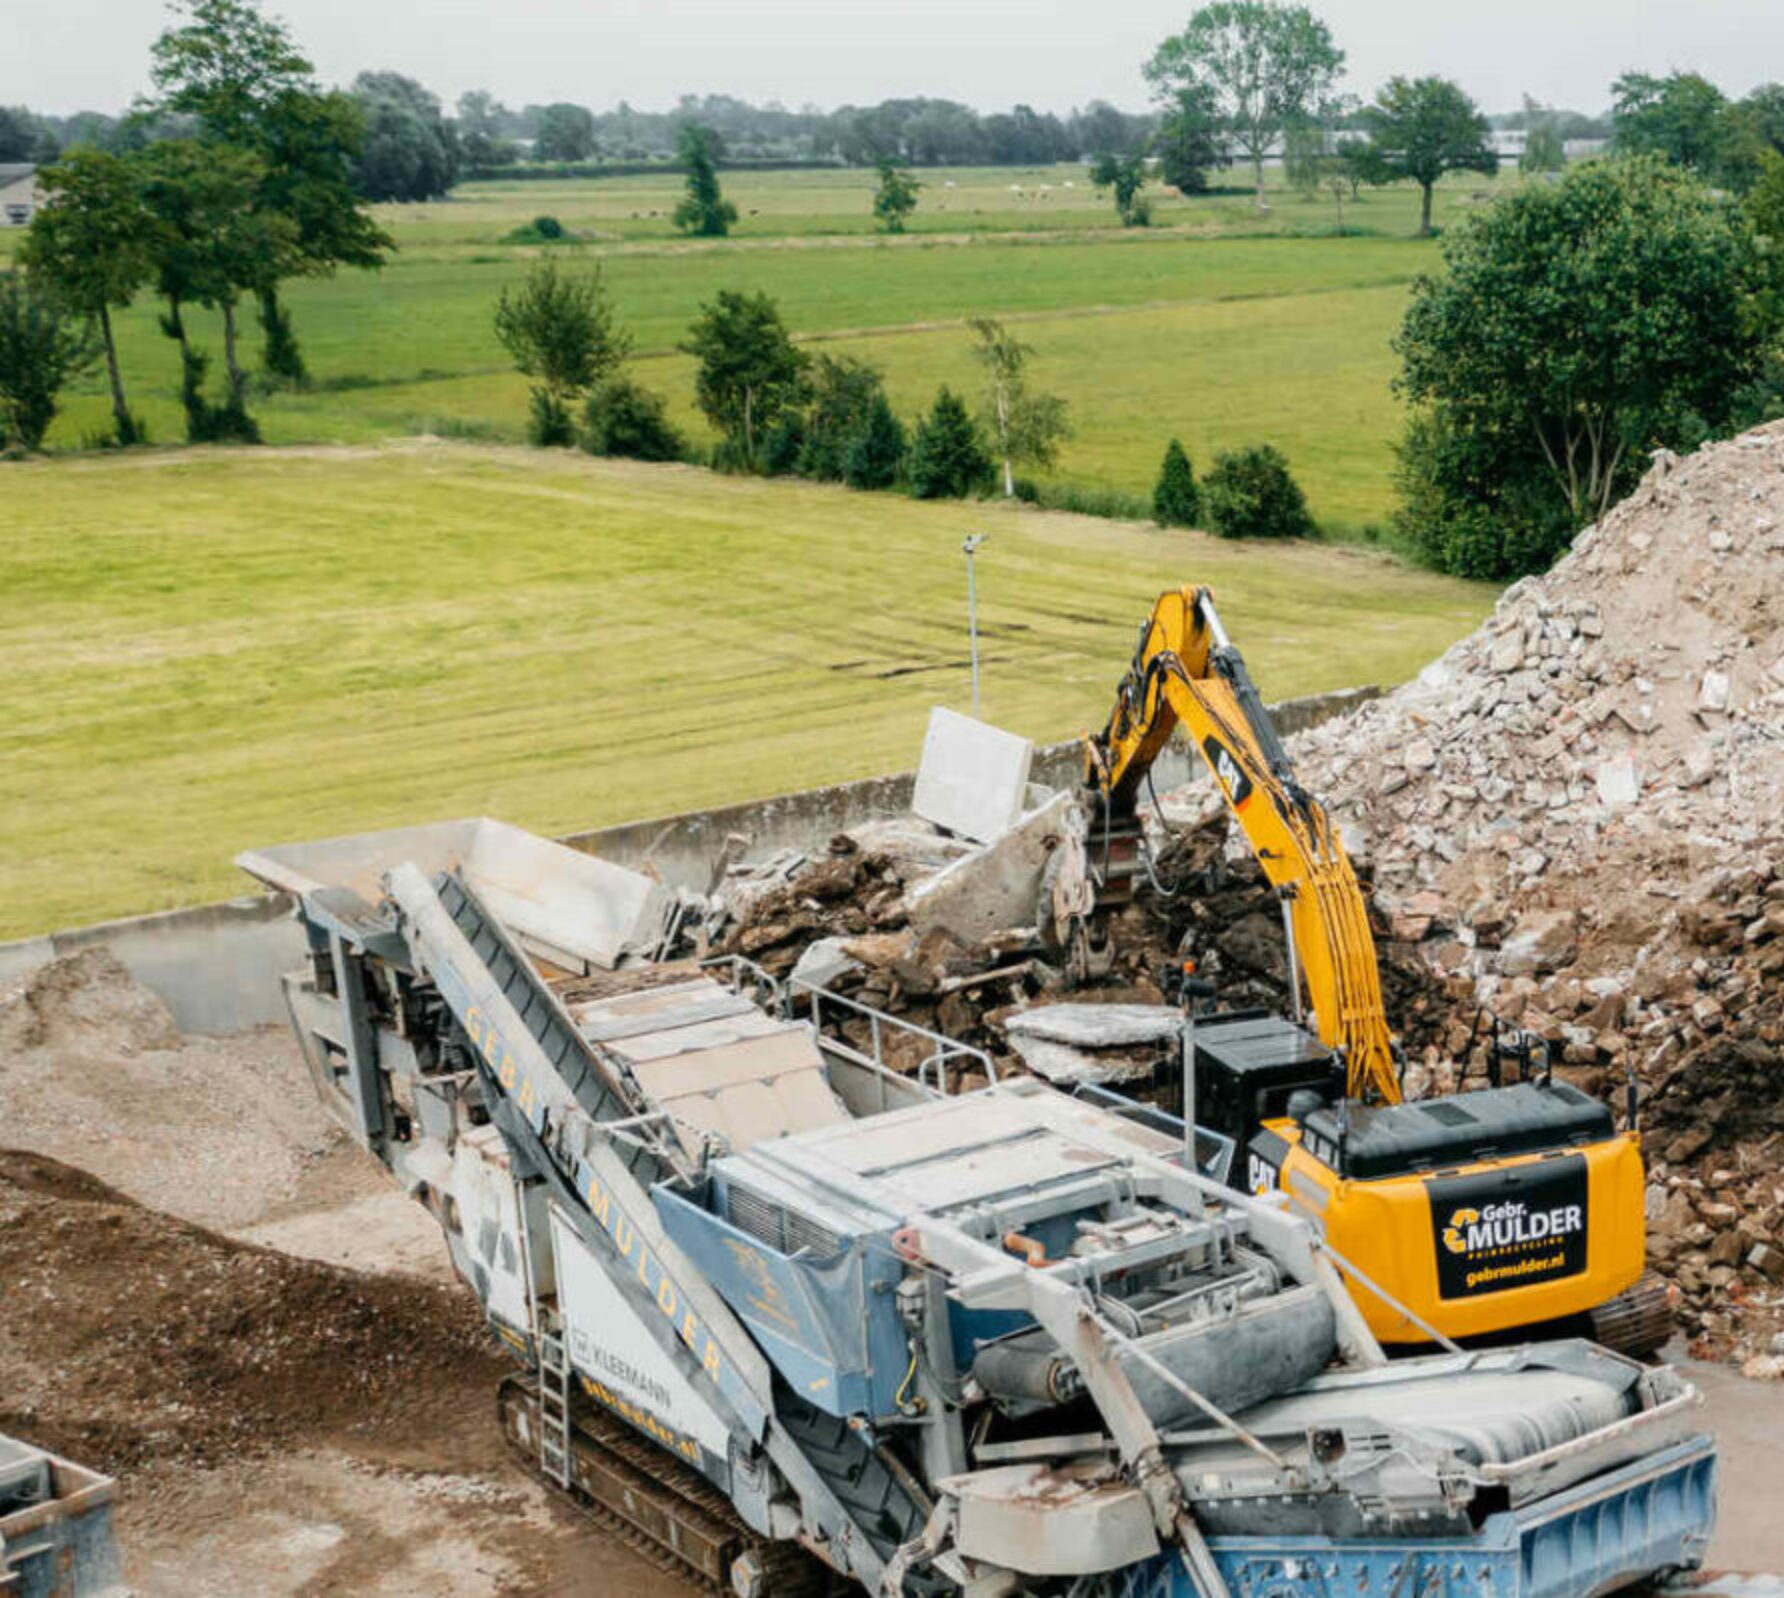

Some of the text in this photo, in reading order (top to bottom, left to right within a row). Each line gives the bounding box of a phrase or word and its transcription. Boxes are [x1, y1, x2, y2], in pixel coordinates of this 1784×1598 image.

[1218, 749, 1241, 800] CAT
[1249, 1154, 1276, 1192] CAT
[1467, 1205, 1582, 1250] MULDER
[1482, 1201, 1527, 1222] Gebr.
[589, 1179, 720, 1383] MULDER
[1466, 1252, 1565, 1287] gebrmulder.nl
[594, 1348, 671, 1409] KLEEMANN
